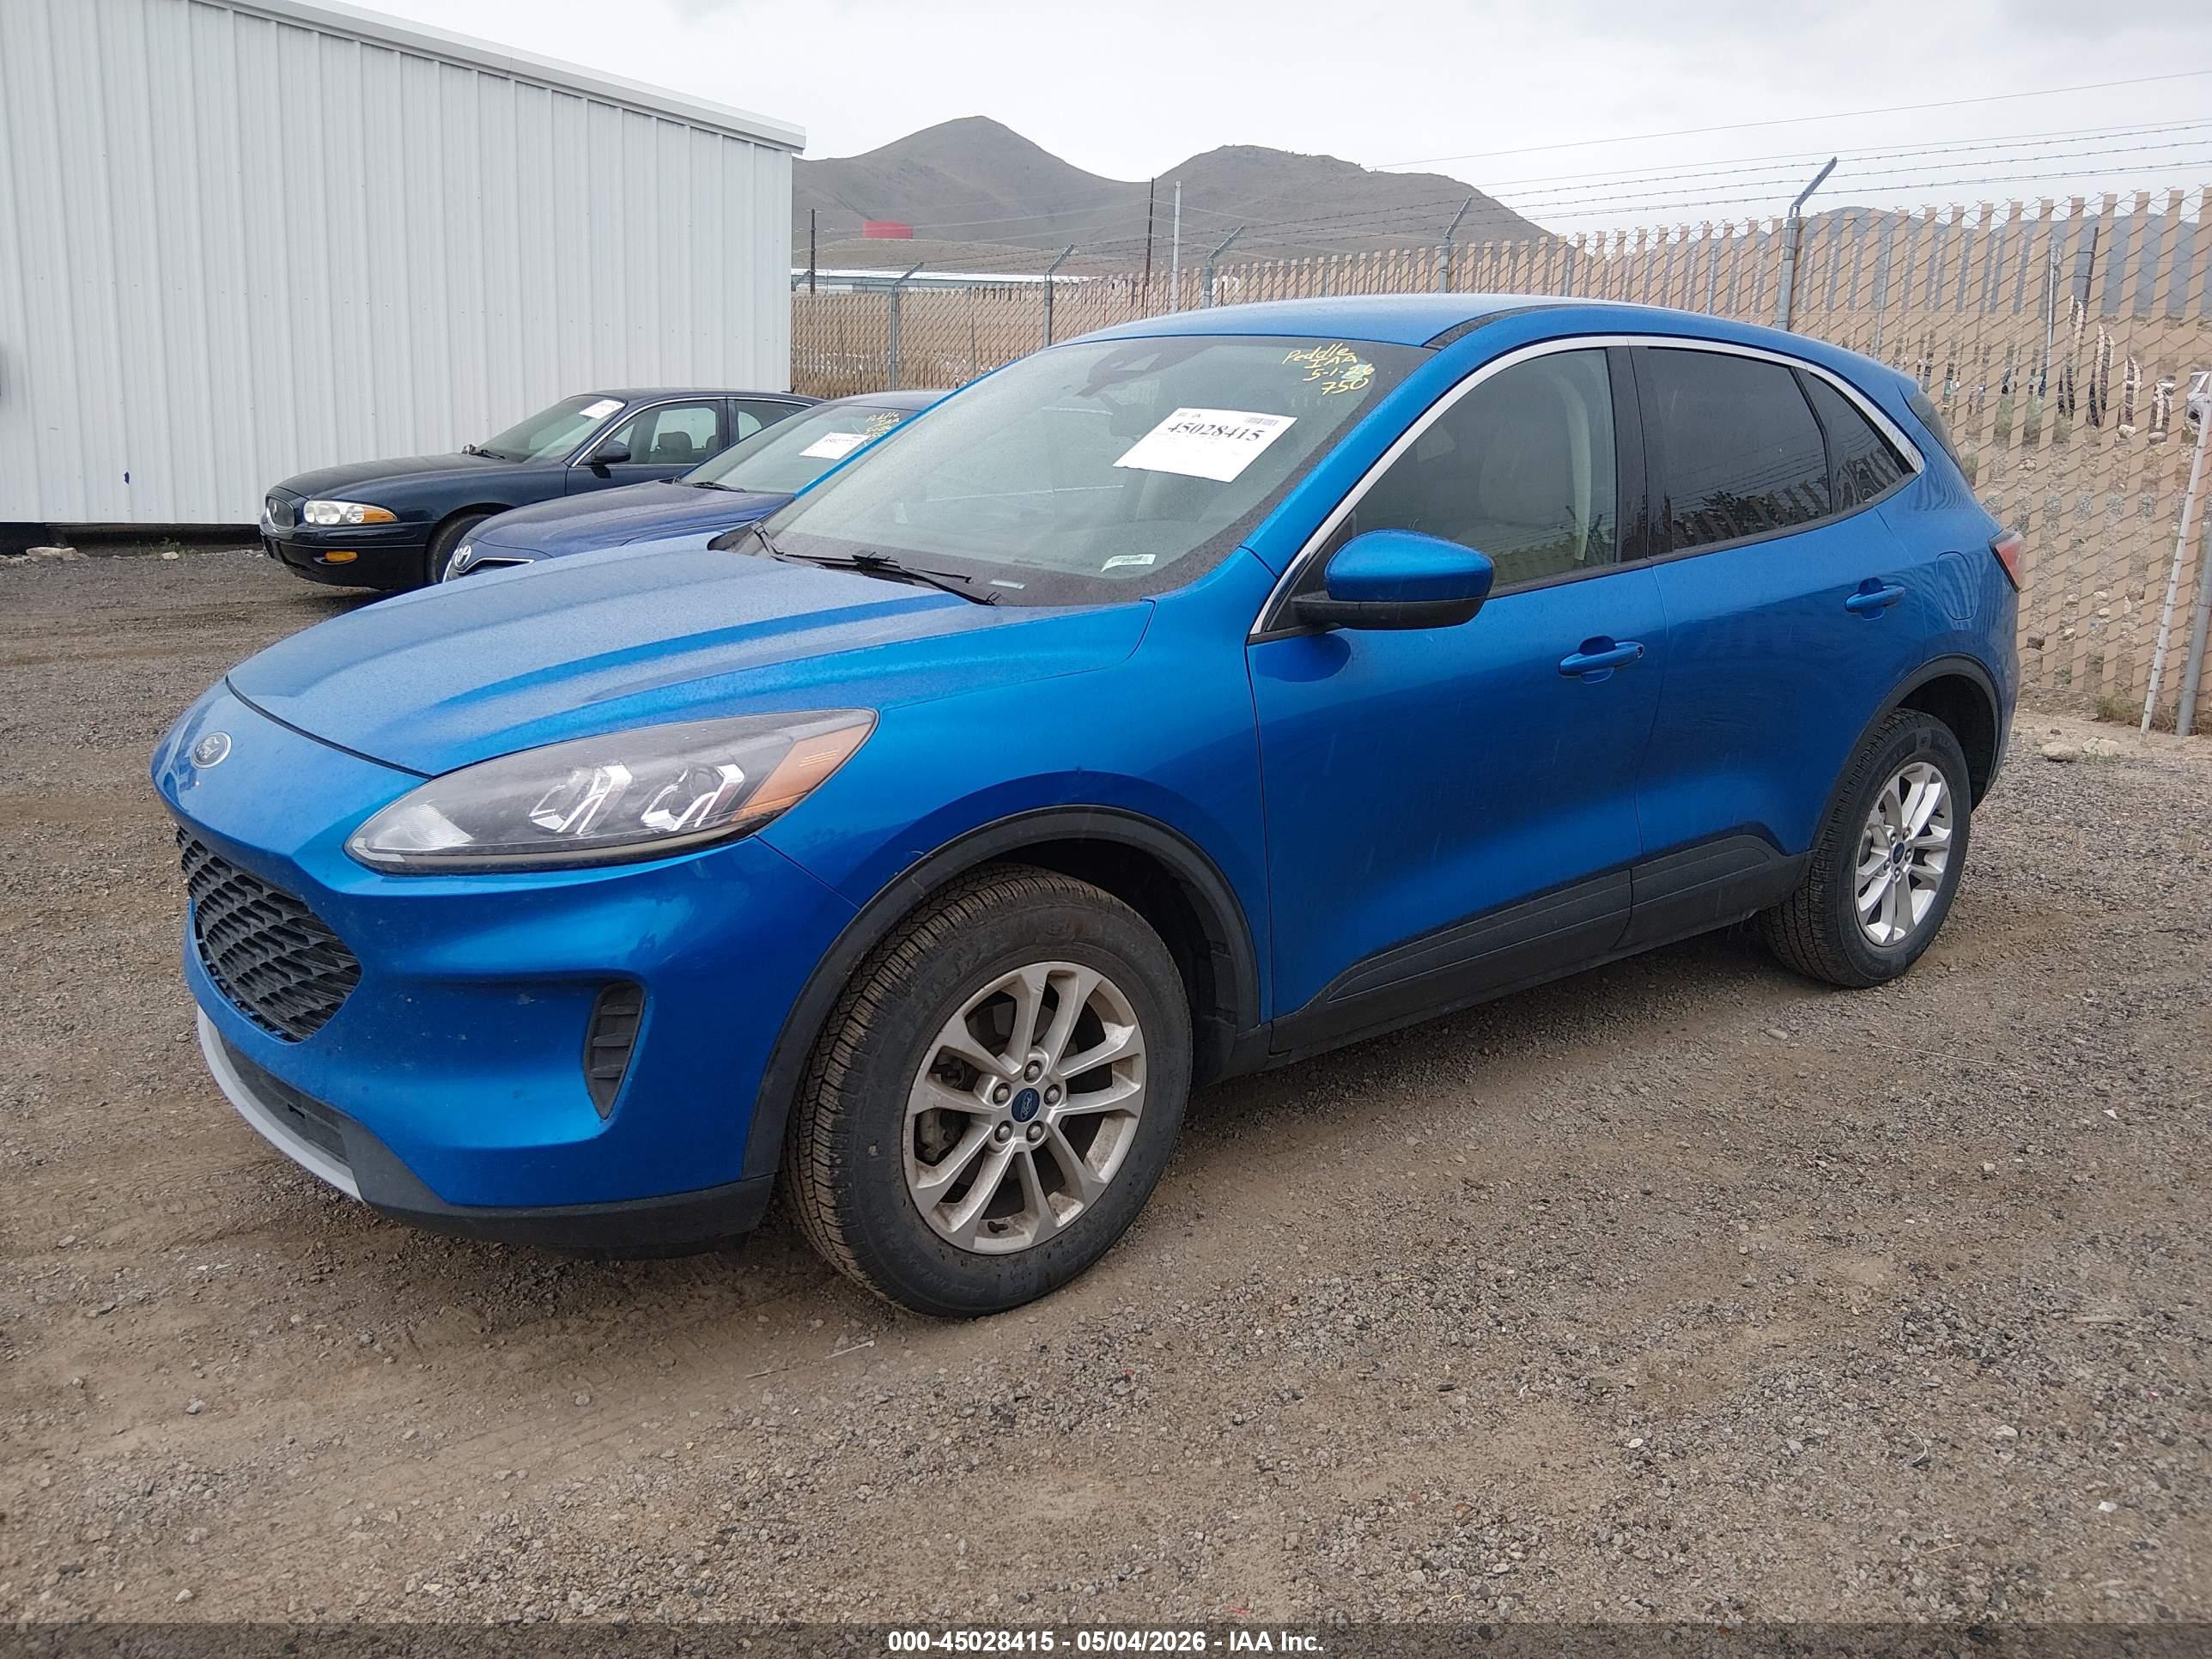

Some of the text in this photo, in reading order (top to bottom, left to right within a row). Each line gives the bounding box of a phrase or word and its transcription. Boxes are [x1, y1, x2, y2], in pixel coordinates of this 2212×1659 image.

[1281, 343, 1355, 365] Peddle
[1304, 356, 1358, 369] IAA
[1321, 377, 1370, 395] 750
[1167, 422, 1265, 441] 45028415
